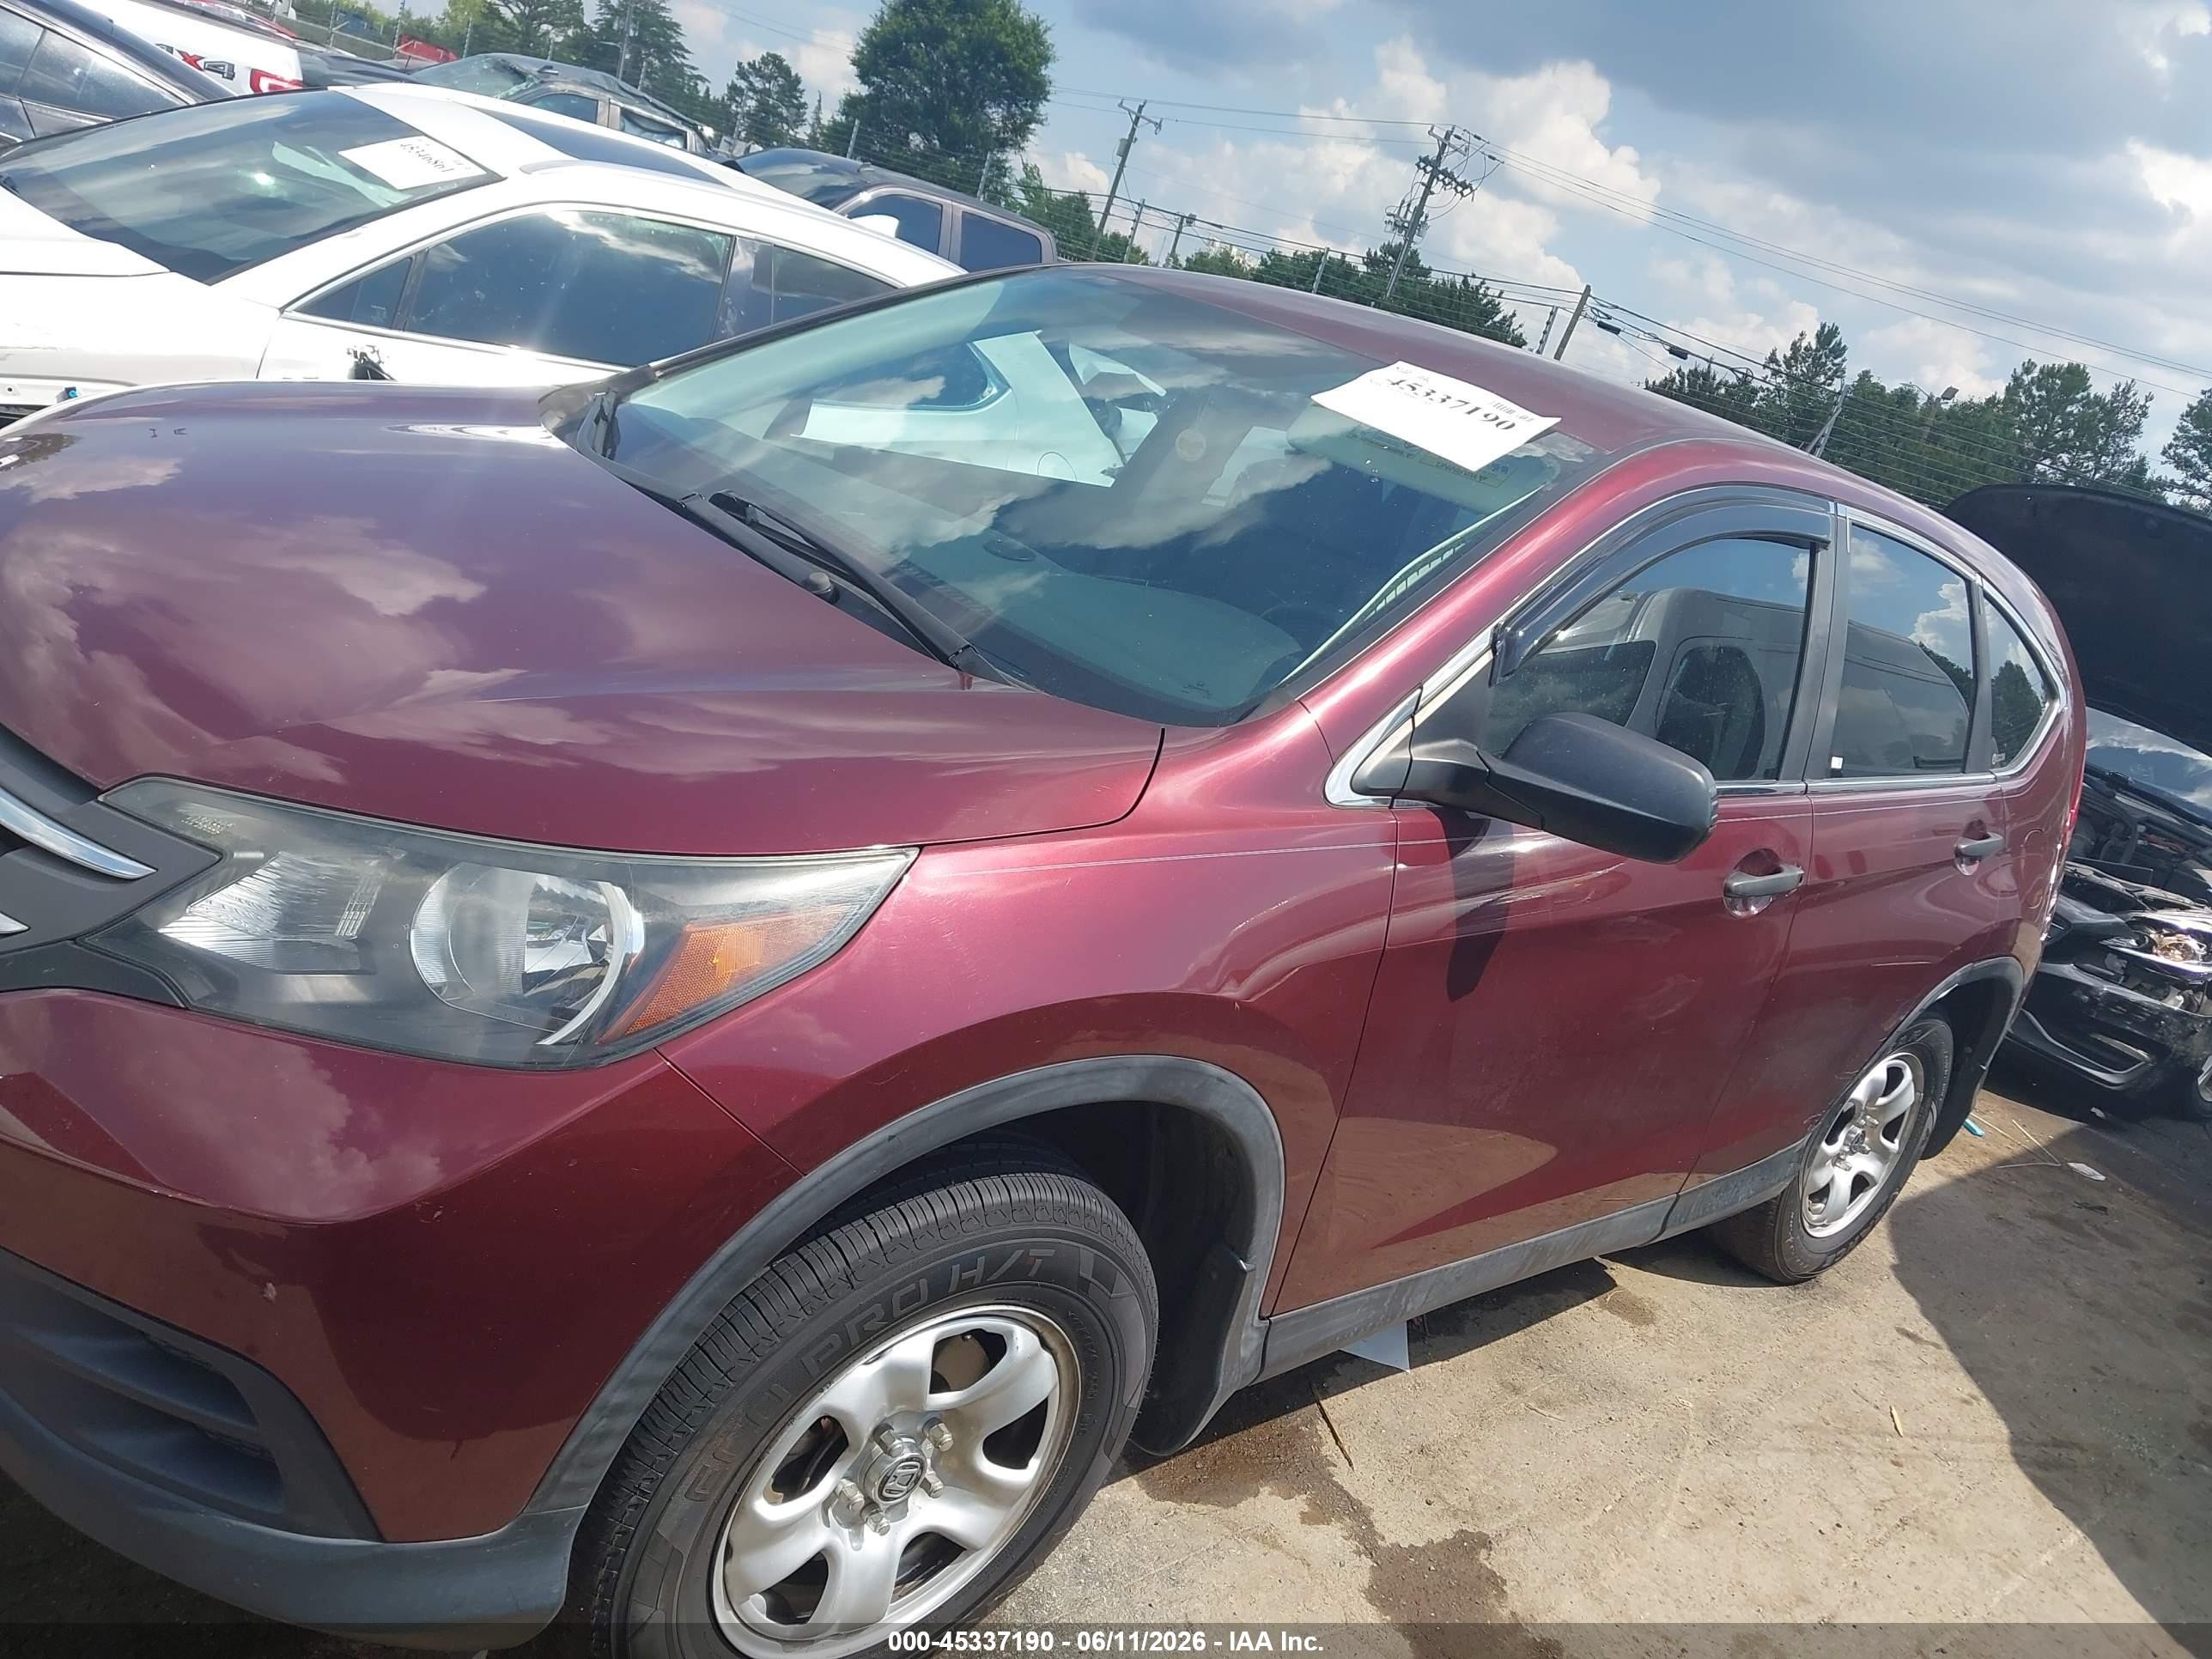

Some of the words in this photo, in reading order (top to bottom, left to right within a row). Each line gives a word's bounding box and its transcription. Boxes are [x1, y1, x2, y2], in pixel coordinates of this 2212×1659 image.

[1386, 378, 1516, 430] 45337190
[801, 1278, 929, 1376] PRO
[947, 1249, 1056, 1294] H/T
